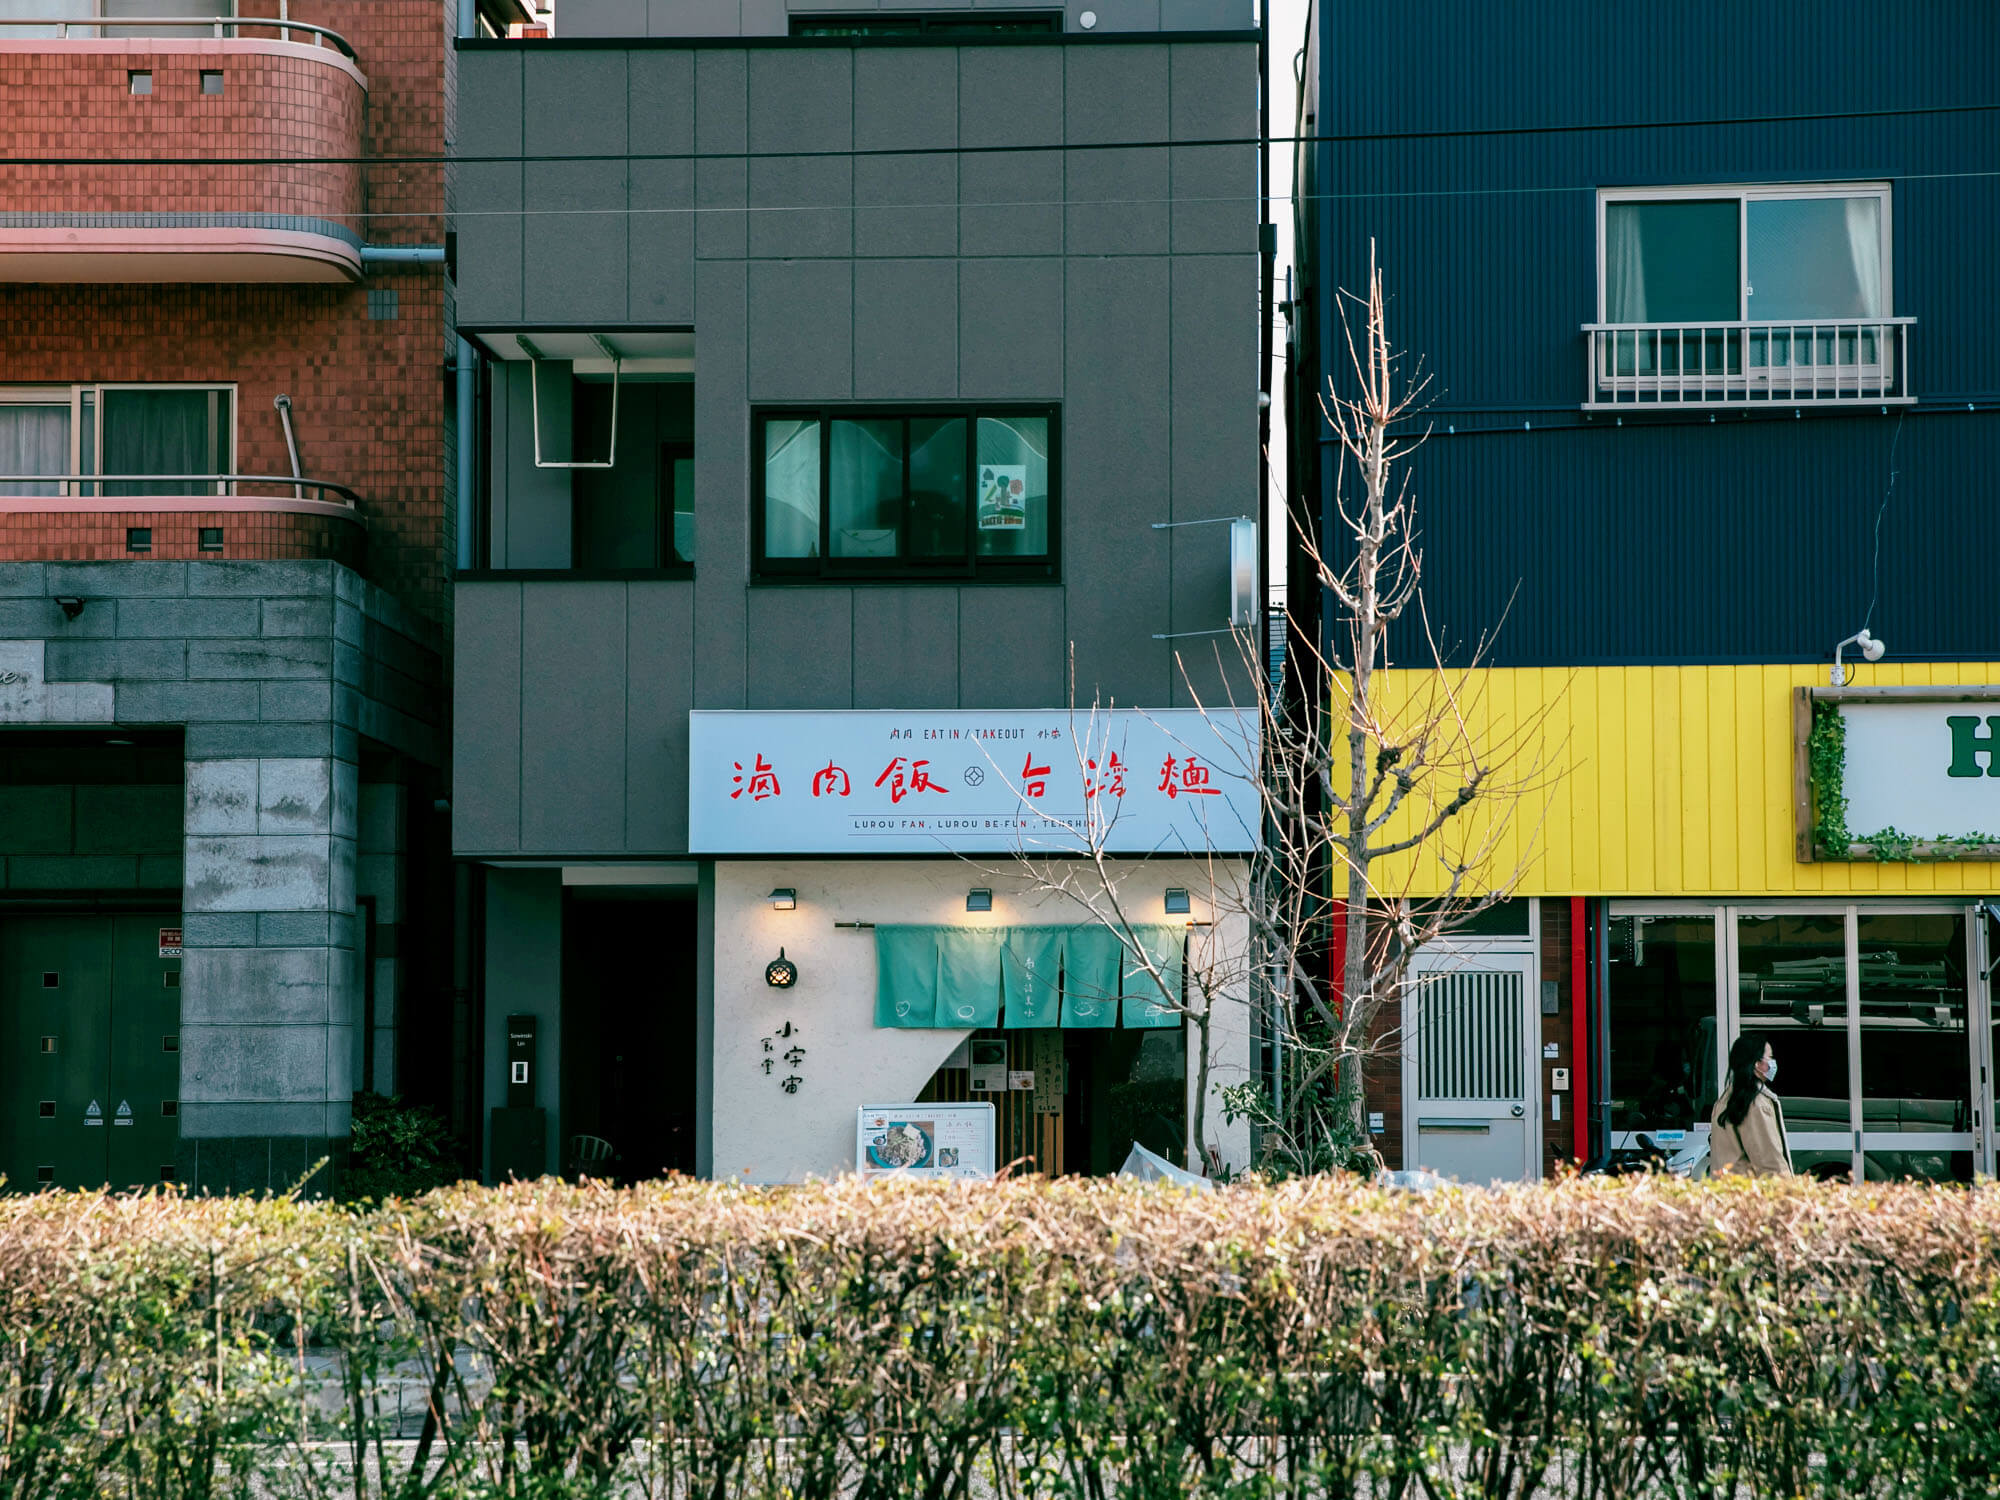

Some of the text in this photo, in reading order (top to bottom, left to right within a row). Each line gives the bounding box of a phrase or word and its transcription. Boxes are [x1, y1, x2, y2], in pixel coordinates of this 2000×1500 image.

[854, 820, 895, 829] LUROU
[937, 820, 978, 829] LUROU
[760, 1037, 775, 1075] 食堂
[775, 1020, 806, 1095] 小宇宙
